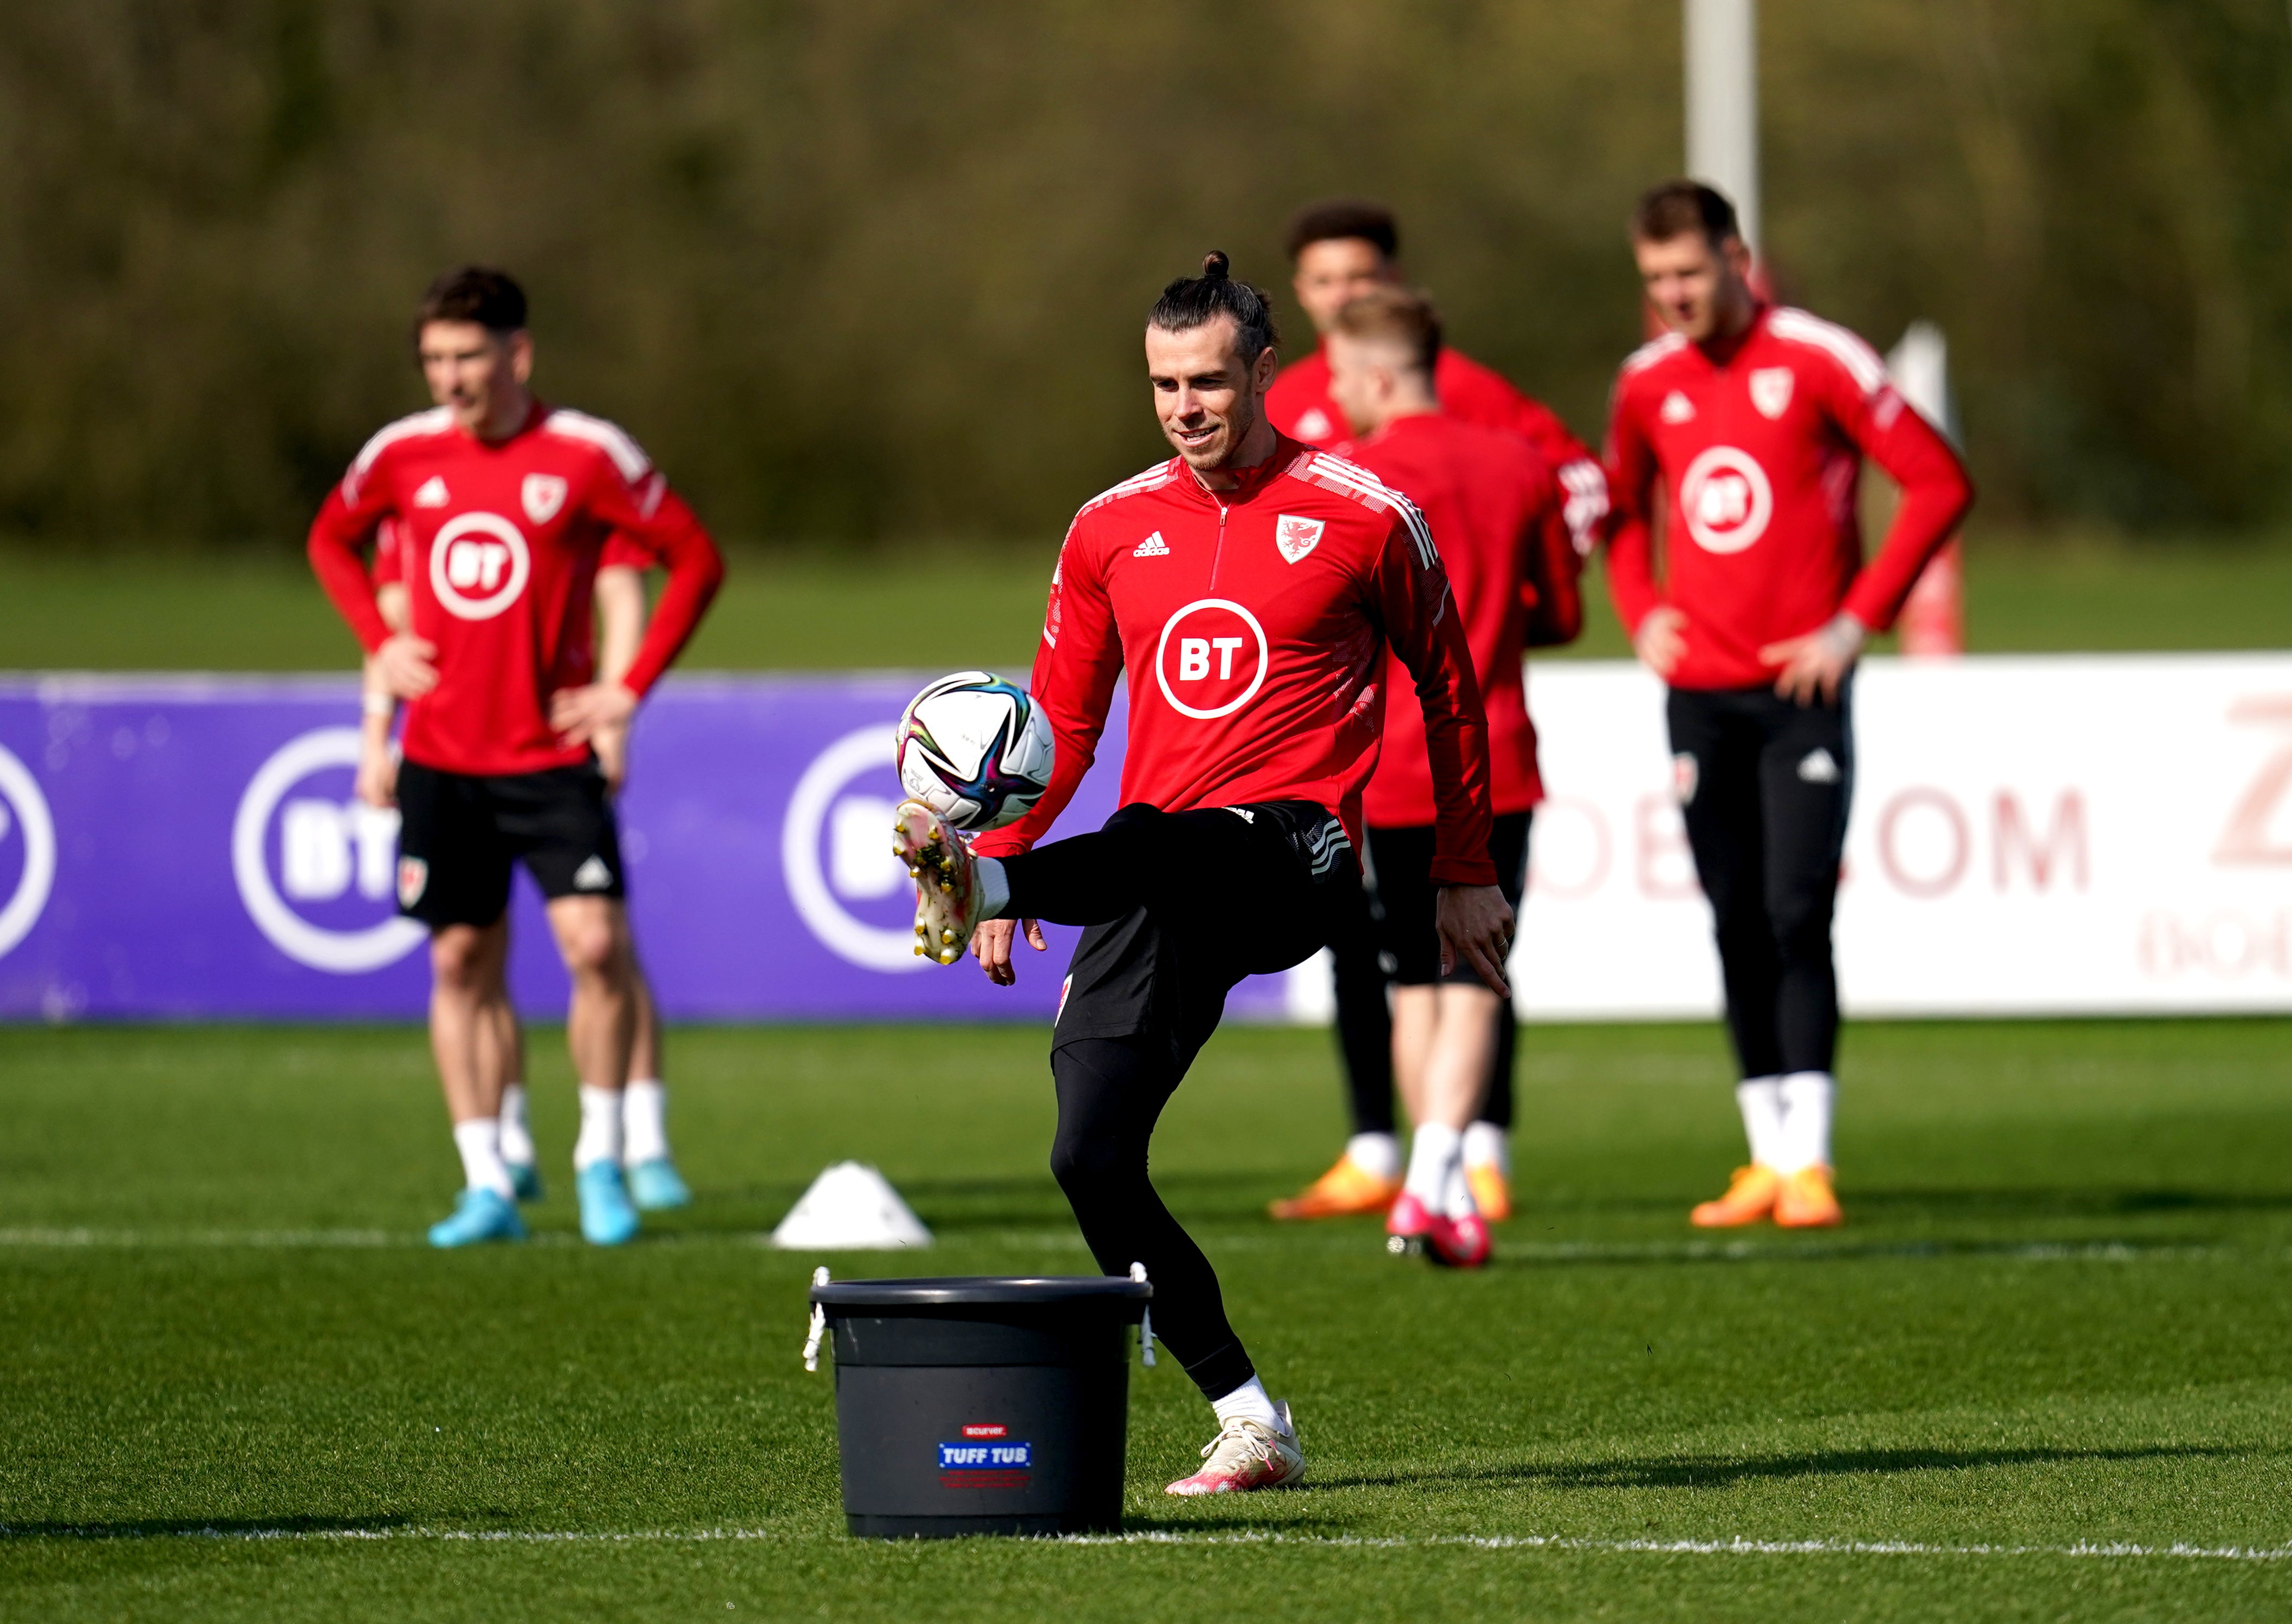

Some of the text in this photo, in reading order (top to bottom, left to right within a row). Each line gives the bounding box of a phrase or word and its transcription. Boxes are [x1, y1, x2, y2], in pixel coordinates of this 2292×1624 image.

[447, 540, 509, 590] BT
[1133, 547, 1170, 557] adidas
[1179, 637, 1243, 681] BT
[943, 1447, 1028, 1464] TUFF TUB
